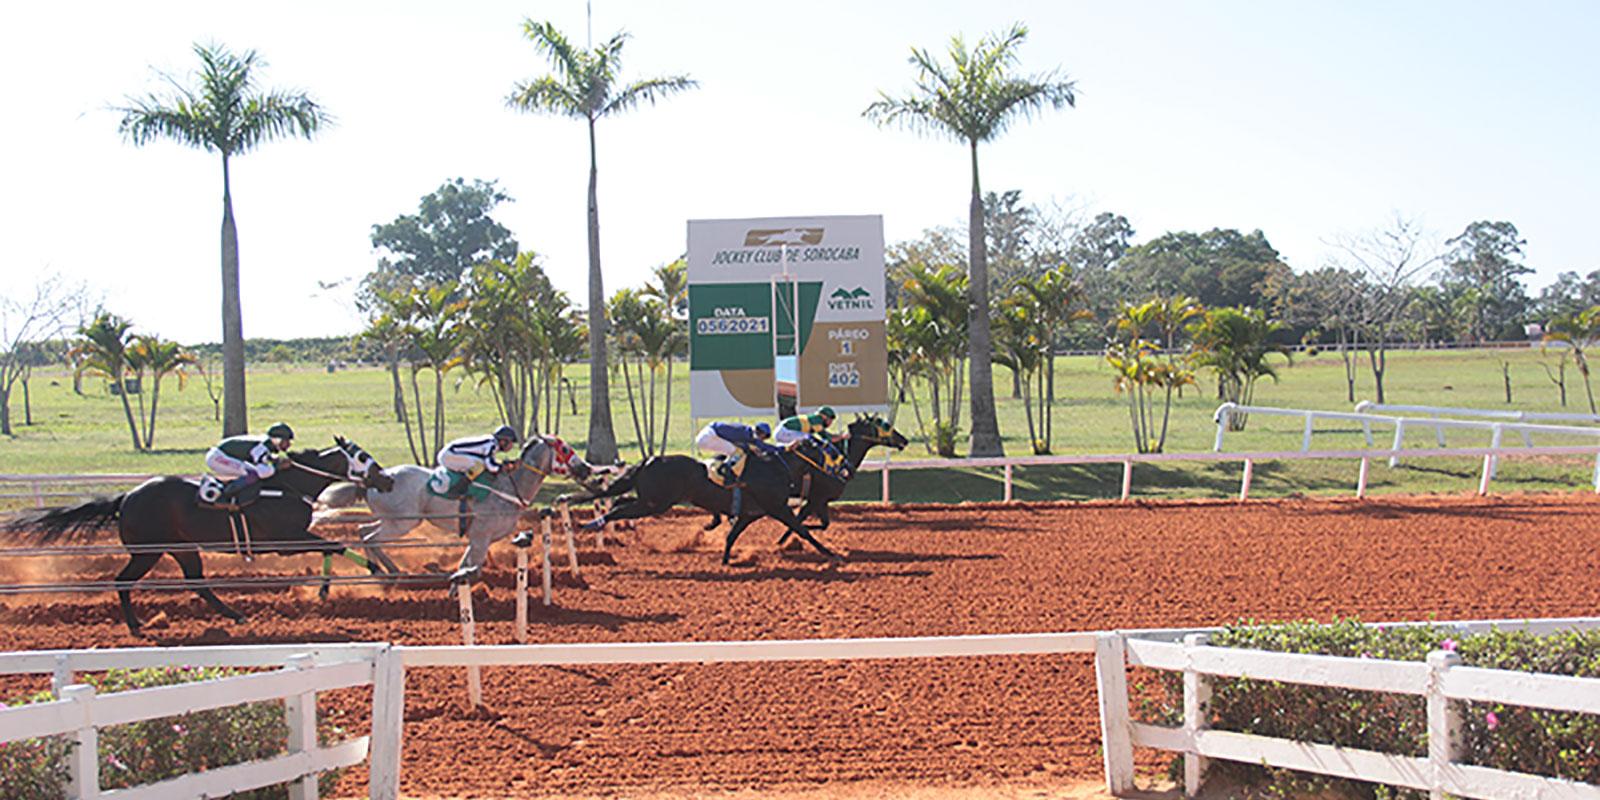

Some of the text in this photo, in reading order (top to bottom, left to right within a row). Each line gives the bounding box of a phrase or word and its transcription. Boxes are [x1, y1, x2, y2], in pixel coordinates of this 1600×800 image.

[711, 246, 860, 265] JOCKEY CLUB DE SOROCABA
[827, 300, 874, 310] VETNIL
[713, 307, 746, 318] DATA
[829, 372, 858, 386] 402
[200, 475, 223, 502] 6
